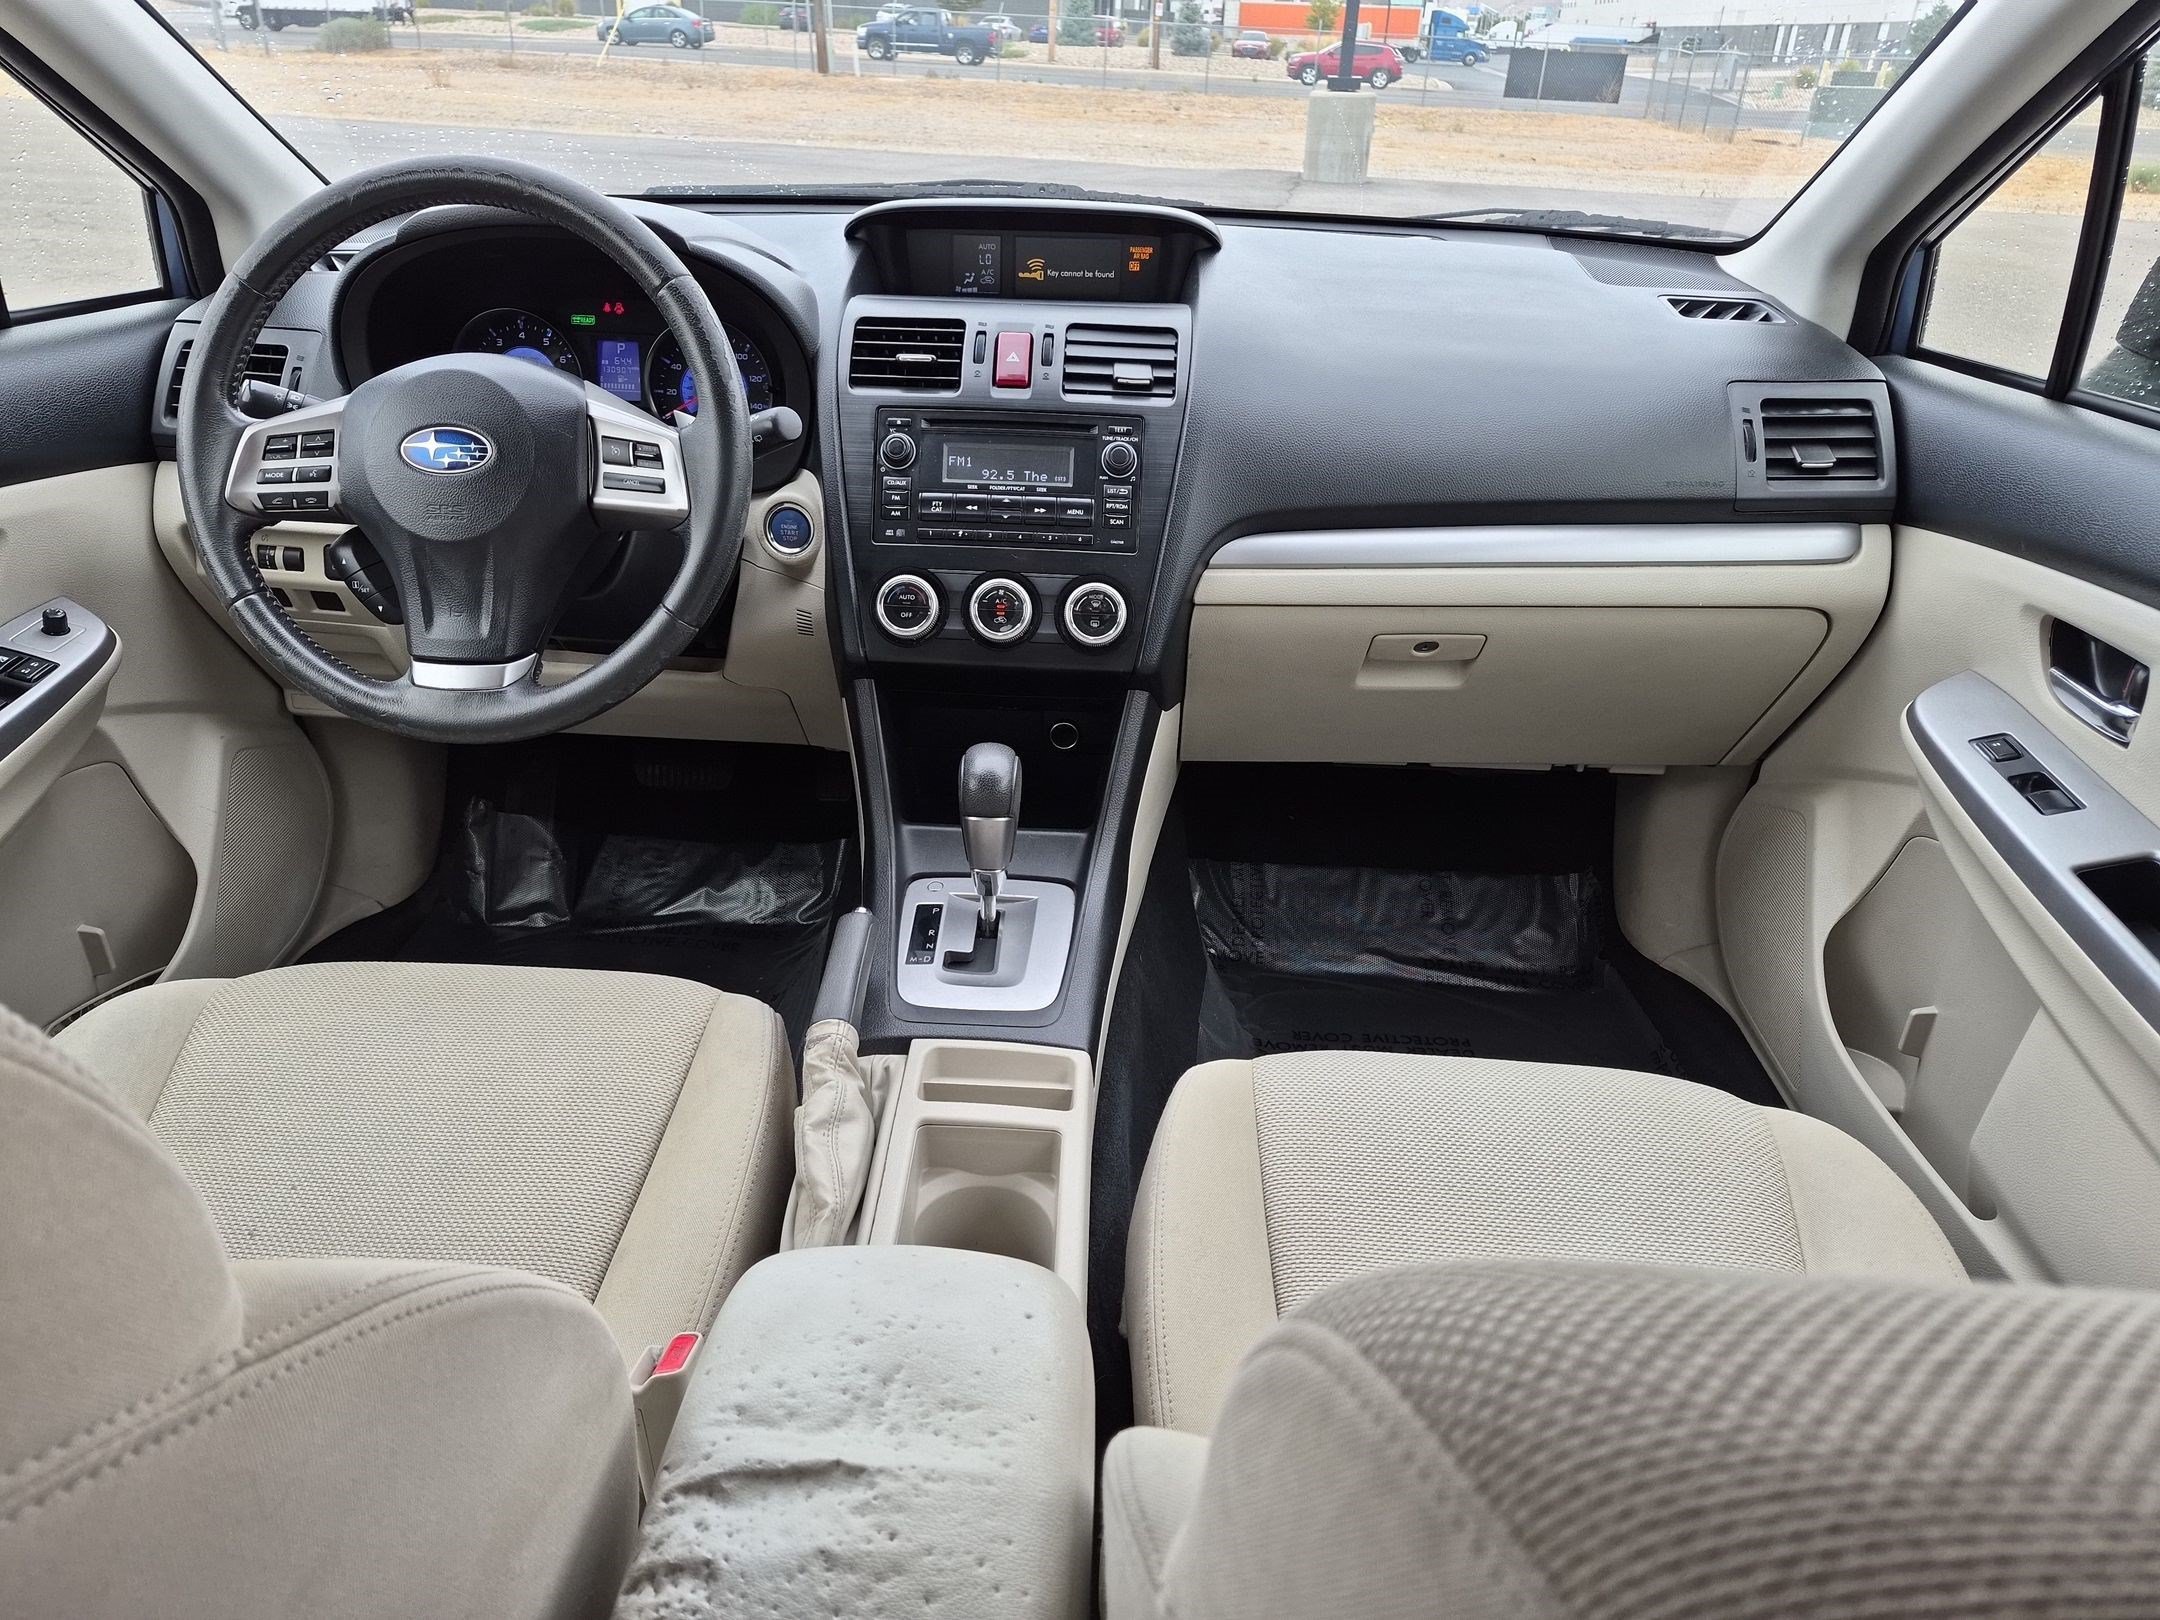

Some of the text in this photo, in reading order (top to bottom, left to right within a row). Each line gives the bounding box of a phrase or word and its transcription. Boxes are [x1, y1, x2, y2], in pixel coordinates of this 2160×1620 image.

[1047, 269, 1059, 278] Key
[1084, 269, 1093, 278] be
[1095, 270, 1115, 278] found
[519, 332, 525, 340] 4
[496, 338, 550, 346] 3 5
[617, 343, 625, 354] P
[949, 455, 972, 467] FM1
[982, 469, 1048, 482] 92.5 The
[1292, 1031, 1470, 1047] PROTECTIVE COVER
